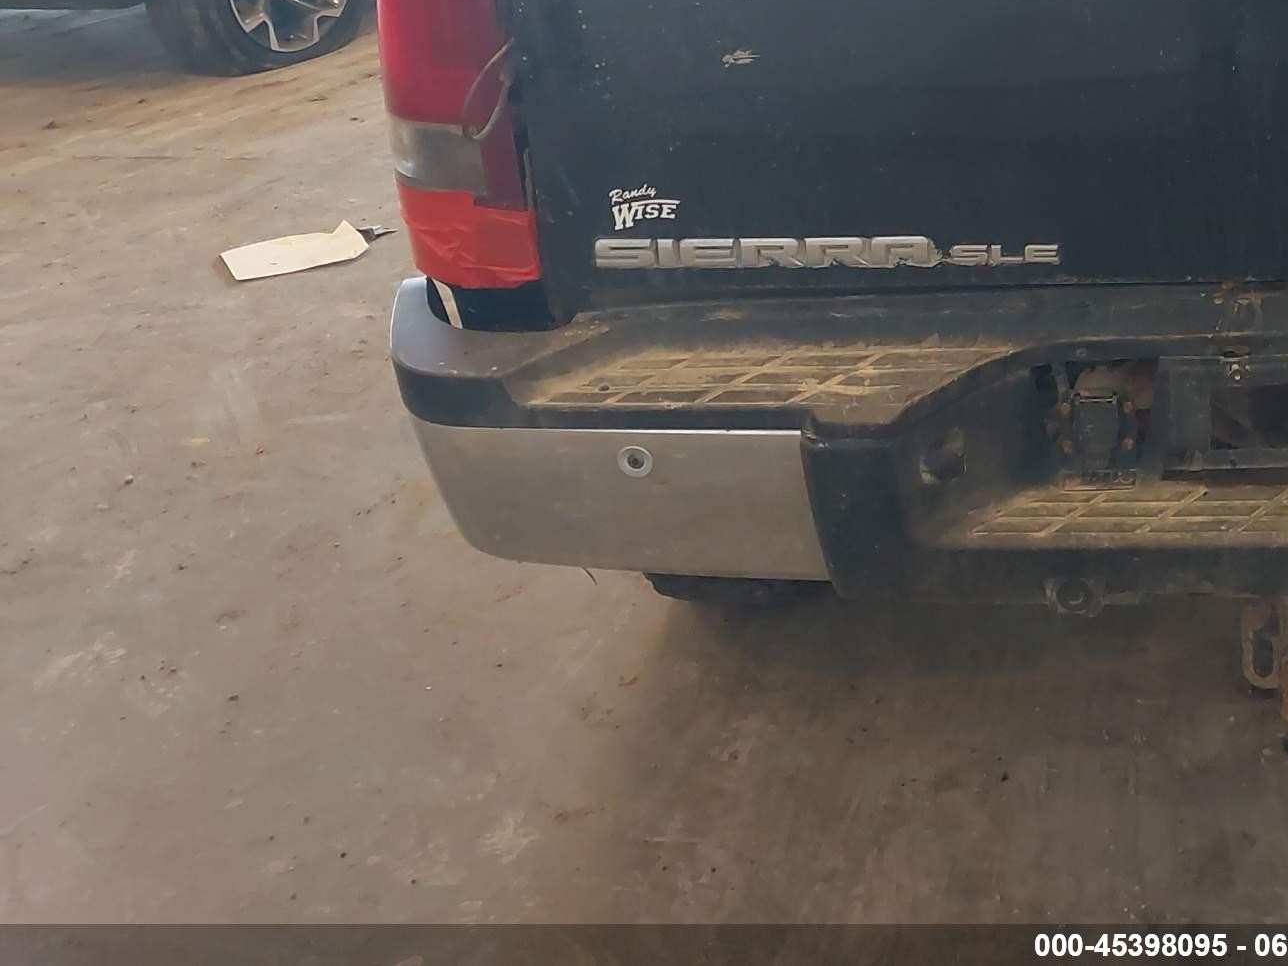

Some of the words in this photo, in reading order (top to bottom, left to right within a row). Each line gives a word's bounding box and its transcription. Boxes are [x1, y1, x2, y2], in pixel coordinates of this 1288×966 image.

[608, 184, 657, 205] Randy
[594, 236, 943, 269] SIERRA
[949, 244, 1061, 267] SLE
